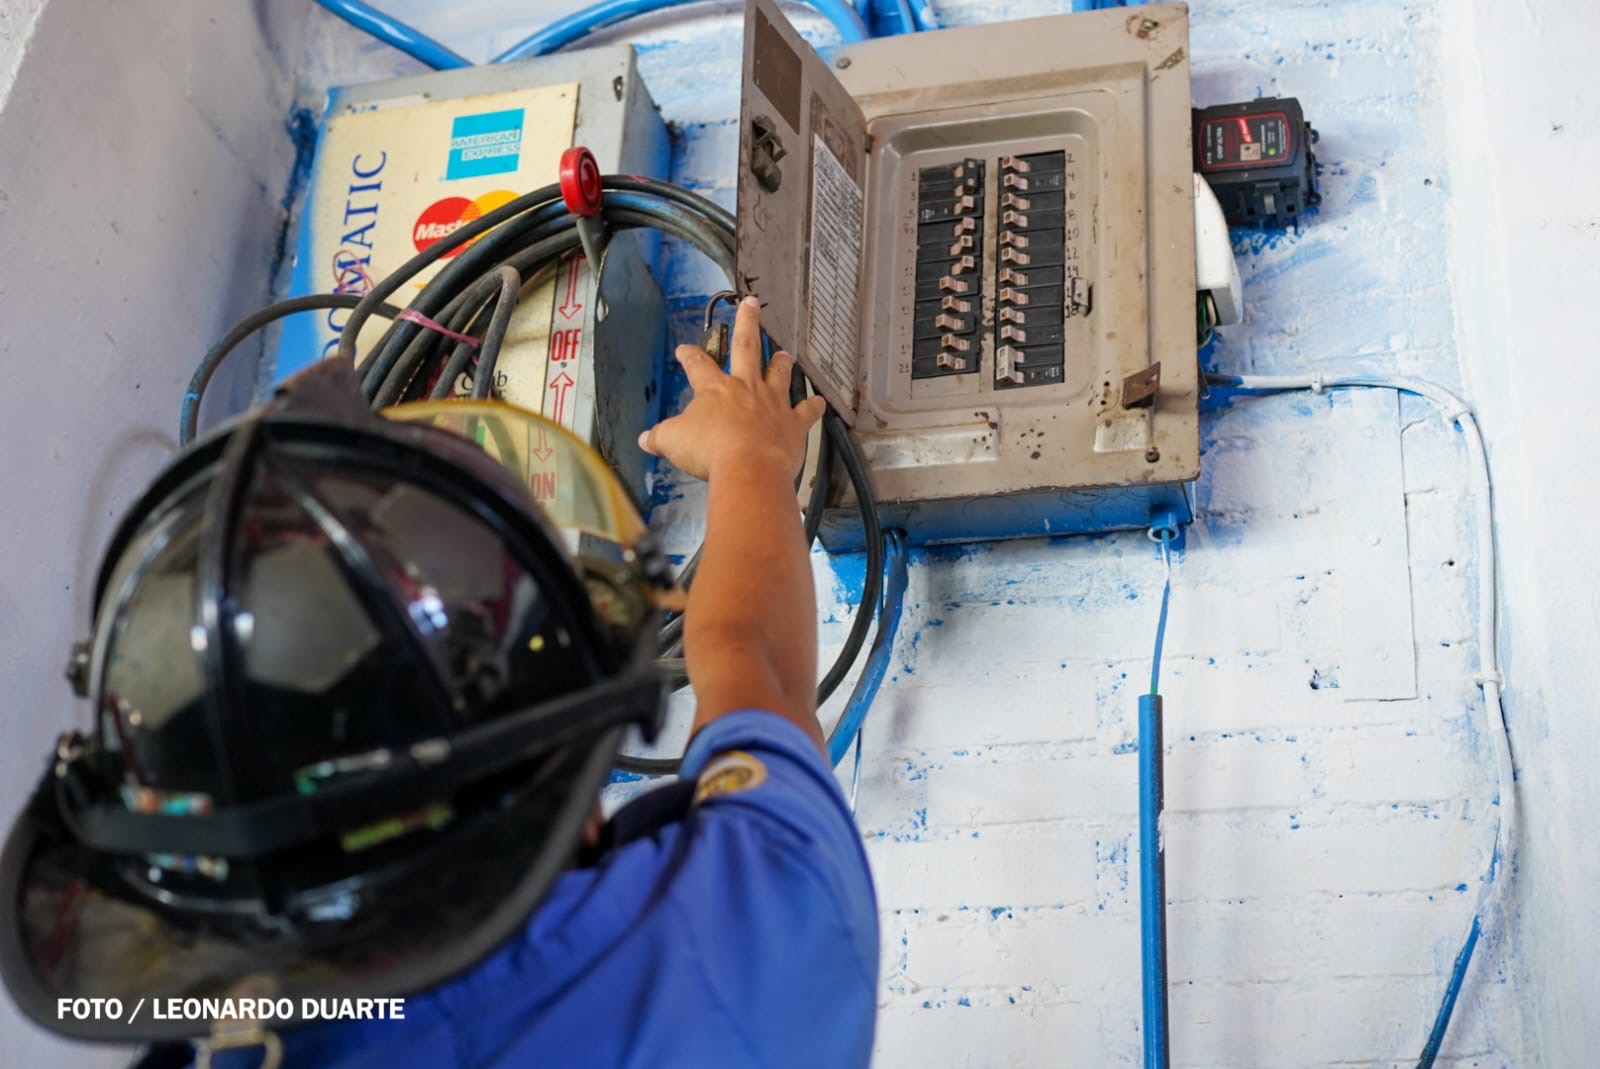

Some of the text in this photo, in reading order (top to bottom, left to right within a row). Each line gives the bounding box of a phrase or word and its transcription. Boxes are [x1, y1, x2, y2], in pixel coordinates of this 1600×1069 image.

[450, 130, 520, 149] AMERICAN
[462, 142, 521, 160] EXPRESS
[321, 150, 388, 361] MATIC
[1066, 247, 1080, 260] 12
[1065, 303, 1079, 319] 18
[551, 328, 581, 362] OFF
[530, 471, 557, 500] ON
